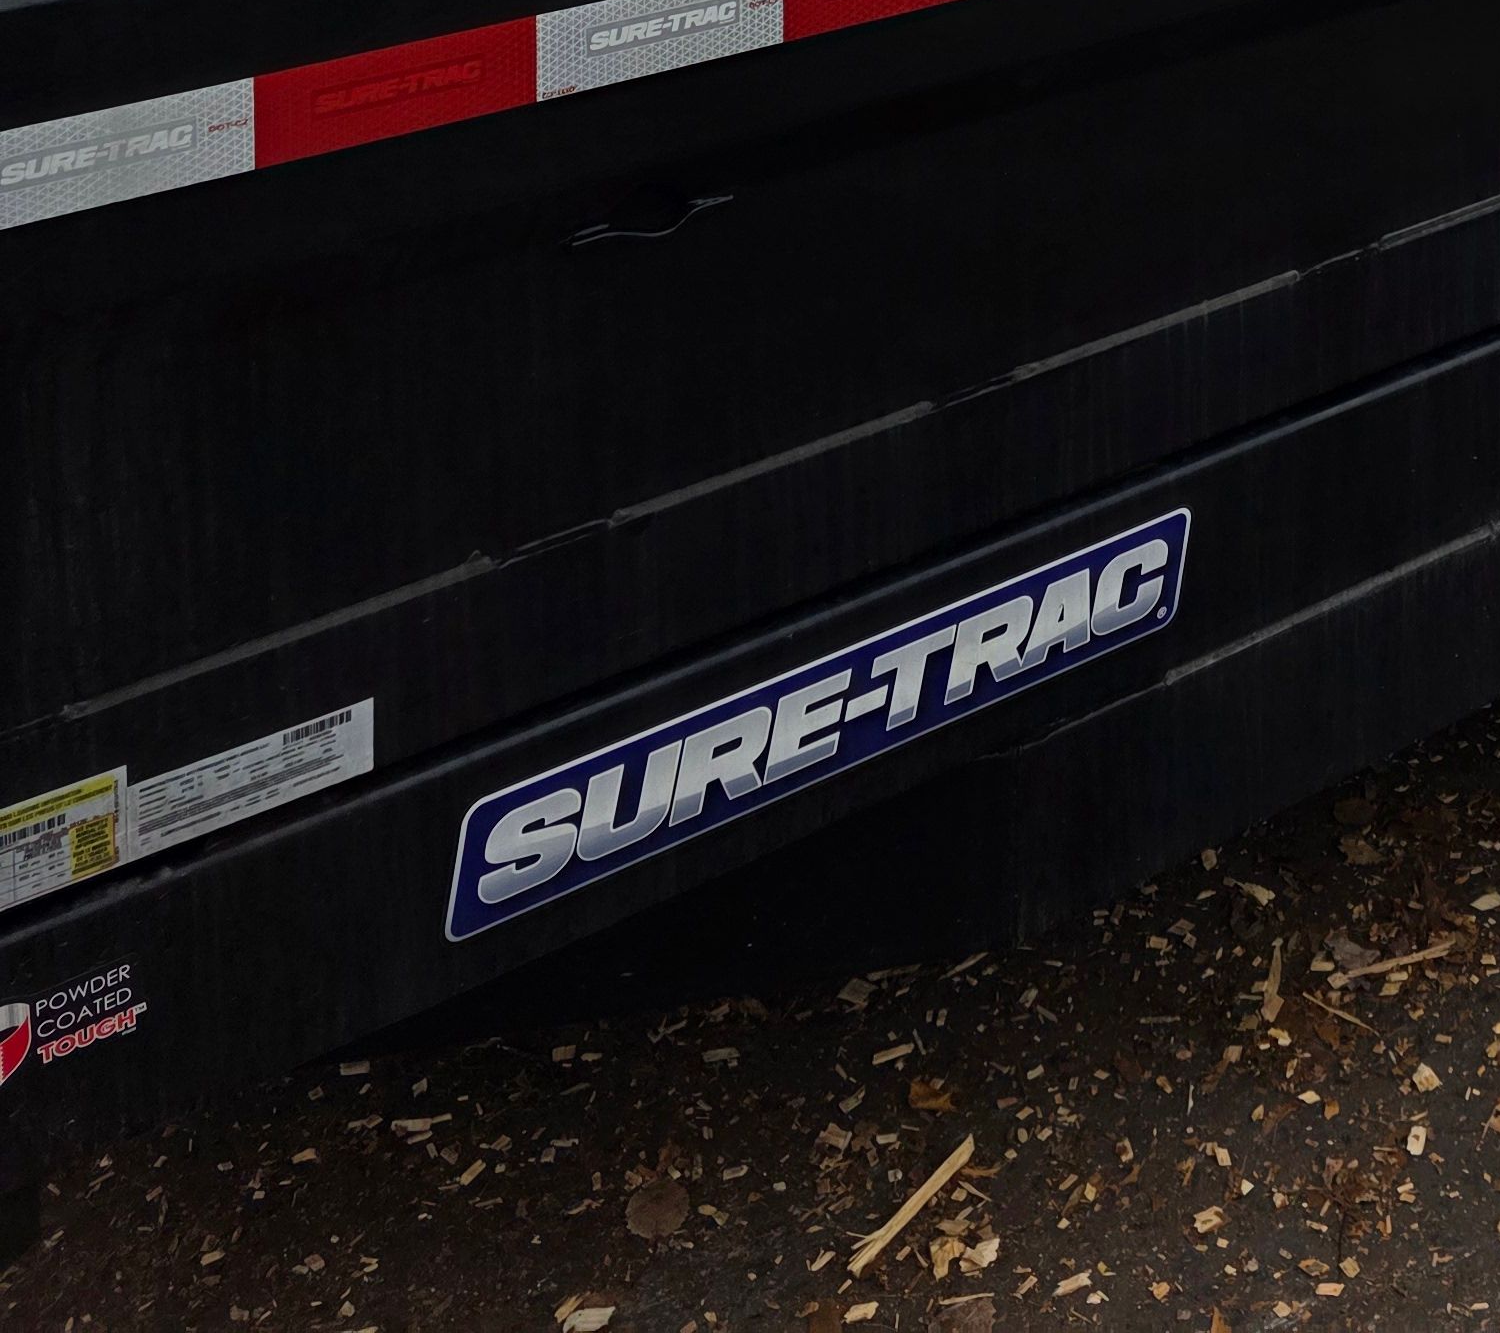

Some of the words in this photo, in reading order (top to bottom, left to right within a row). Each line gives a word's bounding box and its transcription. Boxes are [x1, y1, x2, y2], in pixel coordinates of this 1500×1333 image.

[589, 1, 737, 51] SURE-TRAC
[315, 60, 482, 112] SURE-TRAC
[0, 125, 193, 186] SURE-TRAC
[478, 539, 1168, 903] SURE-TRAC
[36, 964, 130, 1017] POWDER
[37, 987, 132, 1037] COATED
